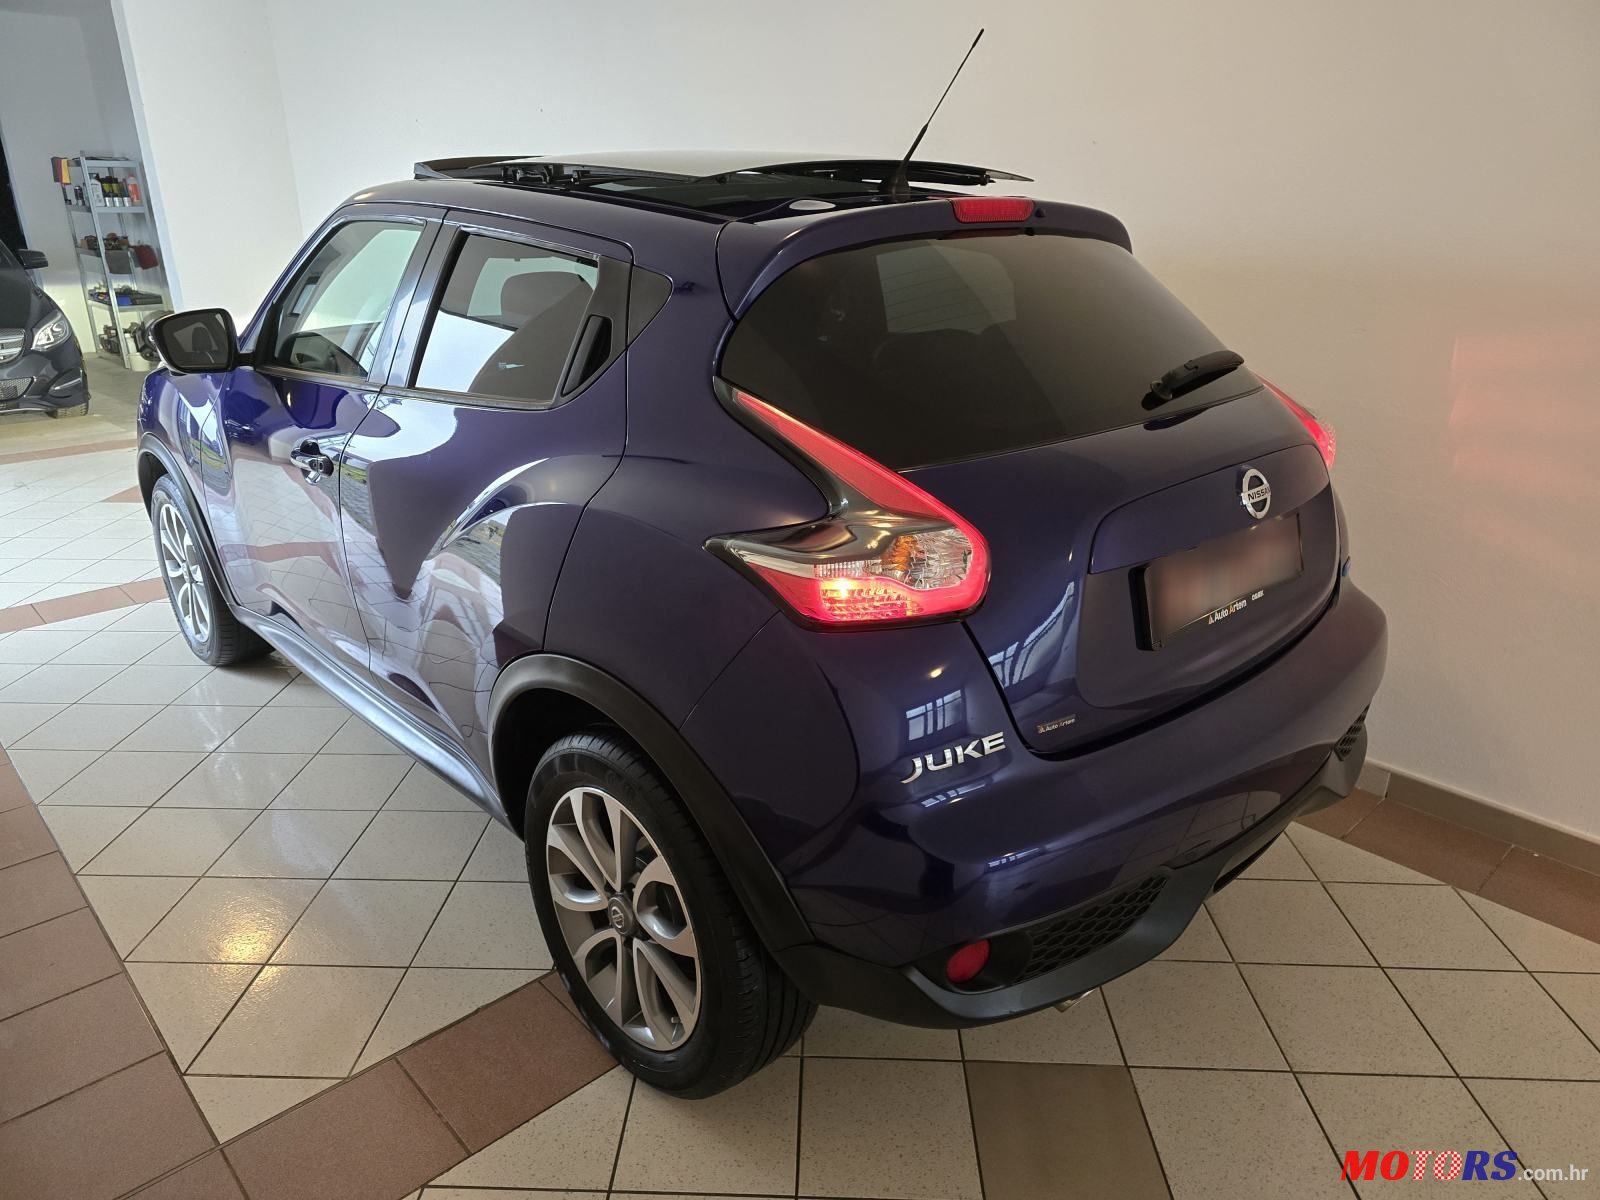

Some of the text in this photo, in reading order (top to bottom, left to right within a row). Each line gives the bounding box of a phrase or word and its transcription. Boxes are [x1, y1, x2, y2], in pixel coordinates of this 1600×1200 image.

[1214, 608, 1229, 622] Auto
[1059, 718, 1075, 727] Arte
[900, 731, 1006, 784] JUKE
